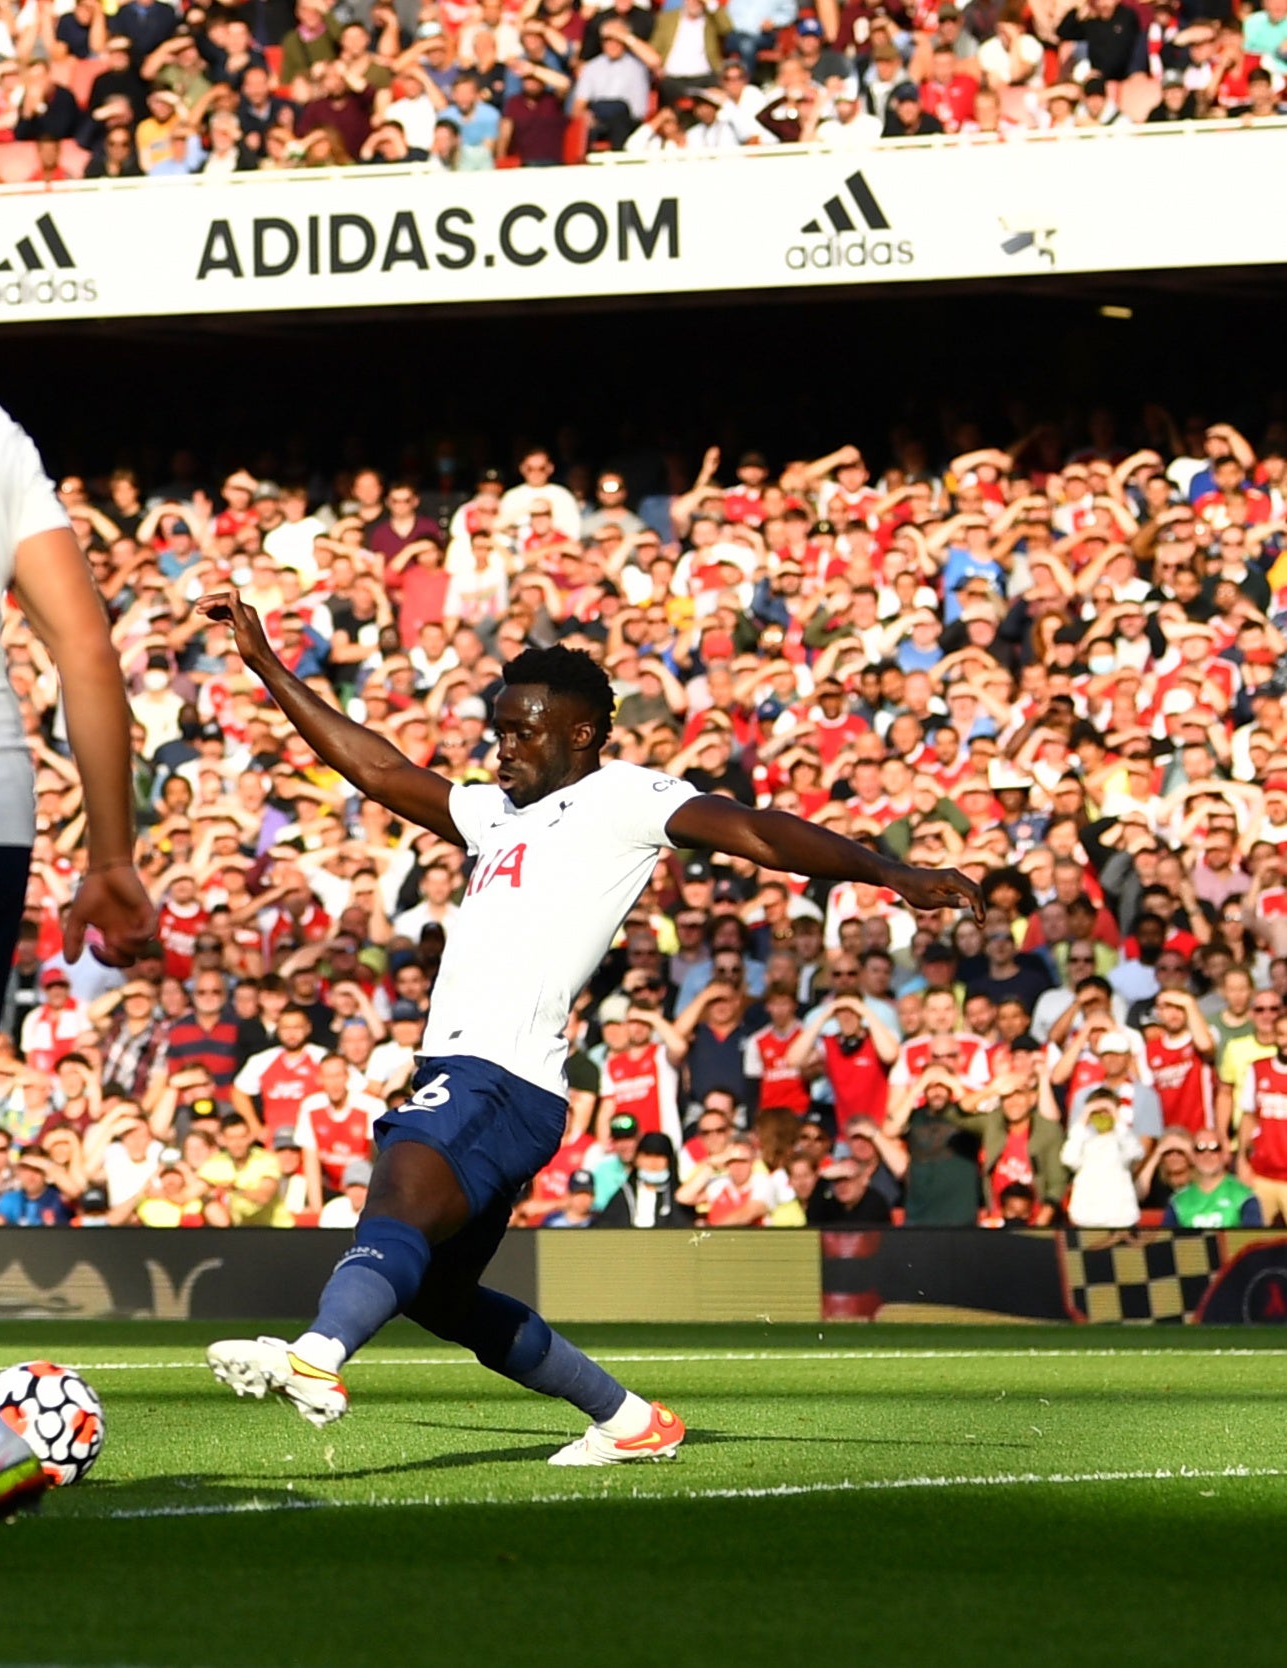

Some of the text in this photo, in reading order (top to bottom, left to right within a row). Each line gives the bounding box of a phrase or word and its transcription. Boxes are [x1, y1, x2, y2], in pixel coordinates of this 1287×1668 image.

[195, 197, 680, 280] ADIDAS.COM
[784, 234, 915, 271] adidas
[411, 1072, 451, 1108] 6
